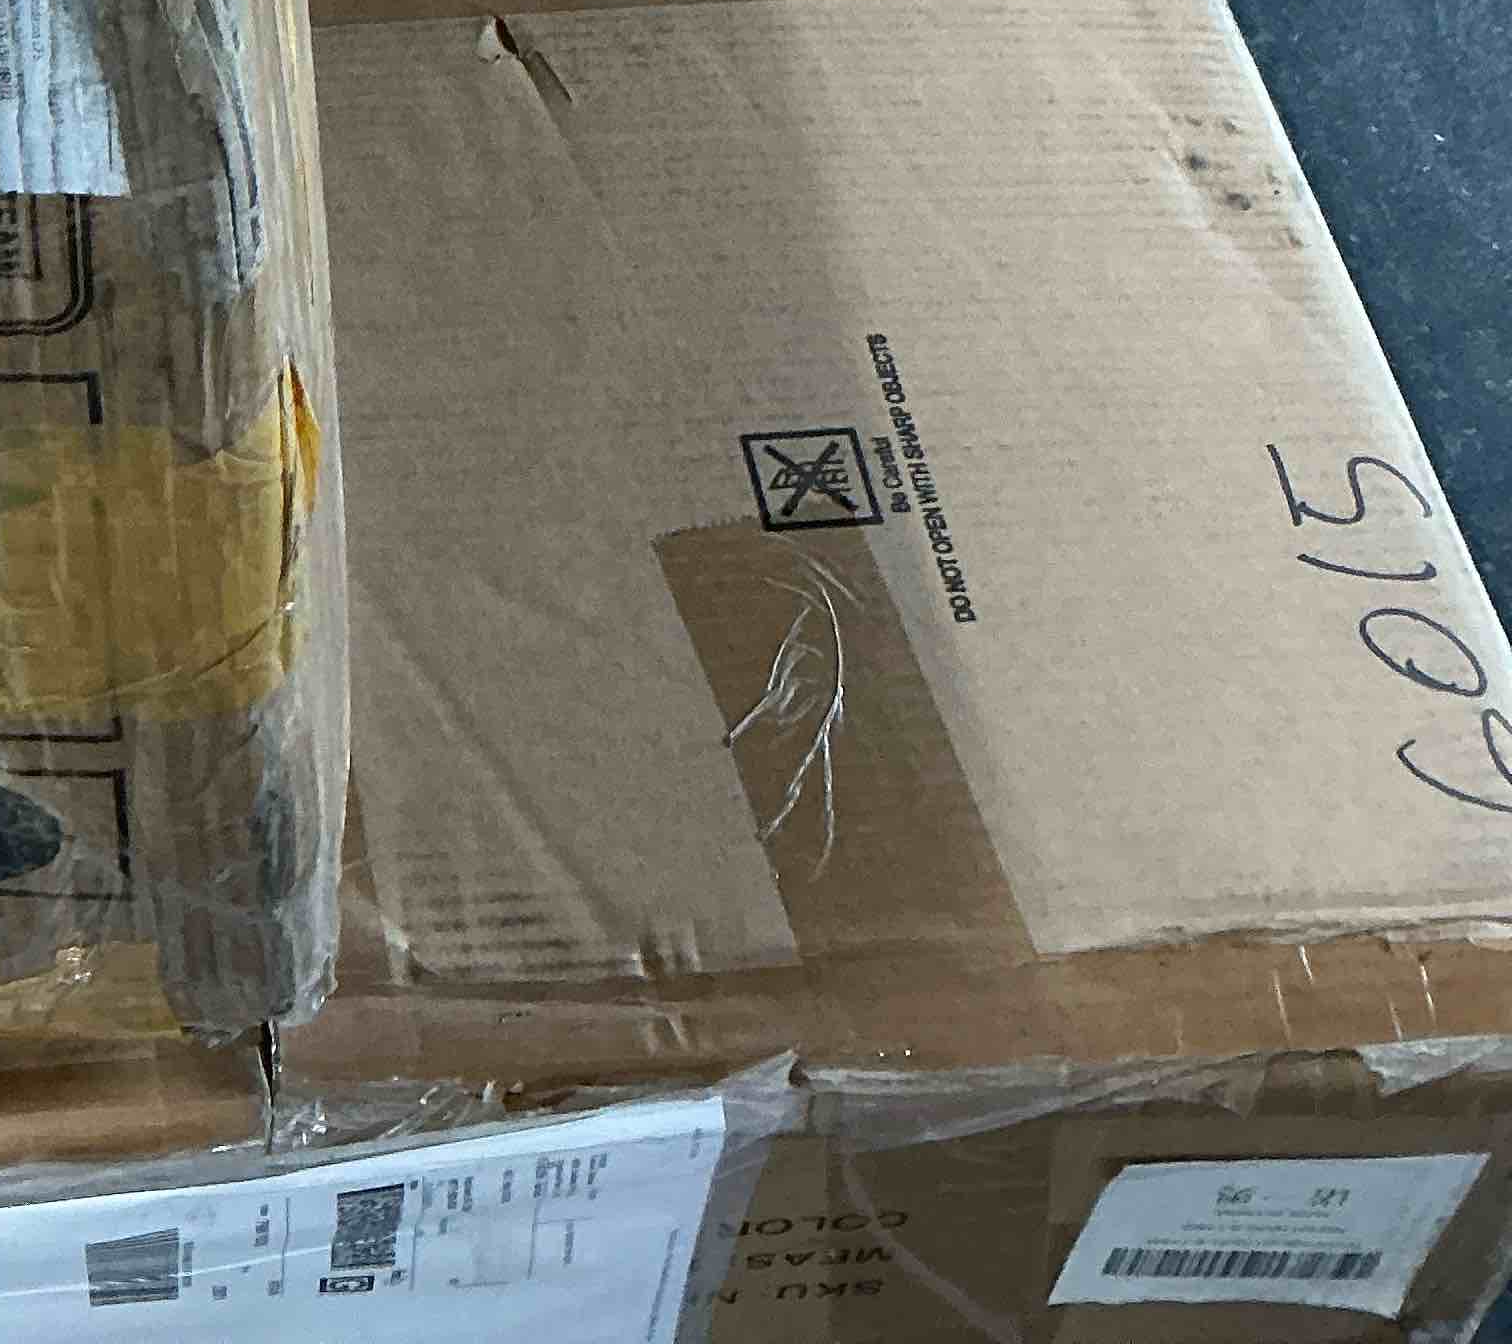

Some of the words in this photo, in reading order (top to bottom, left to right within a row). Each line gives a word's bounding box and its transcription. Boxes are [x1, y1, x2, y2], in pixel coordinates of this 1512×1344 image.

[866, 333, 904, 404] OBJECTS
[890, 406, 925, 459] SHARP
[908, 462, 938, 504] WITH
[922, 506, 954, 553] OPEN
[936, 556, 966, 593] NOT
[950, 596, 976, 622] DO
